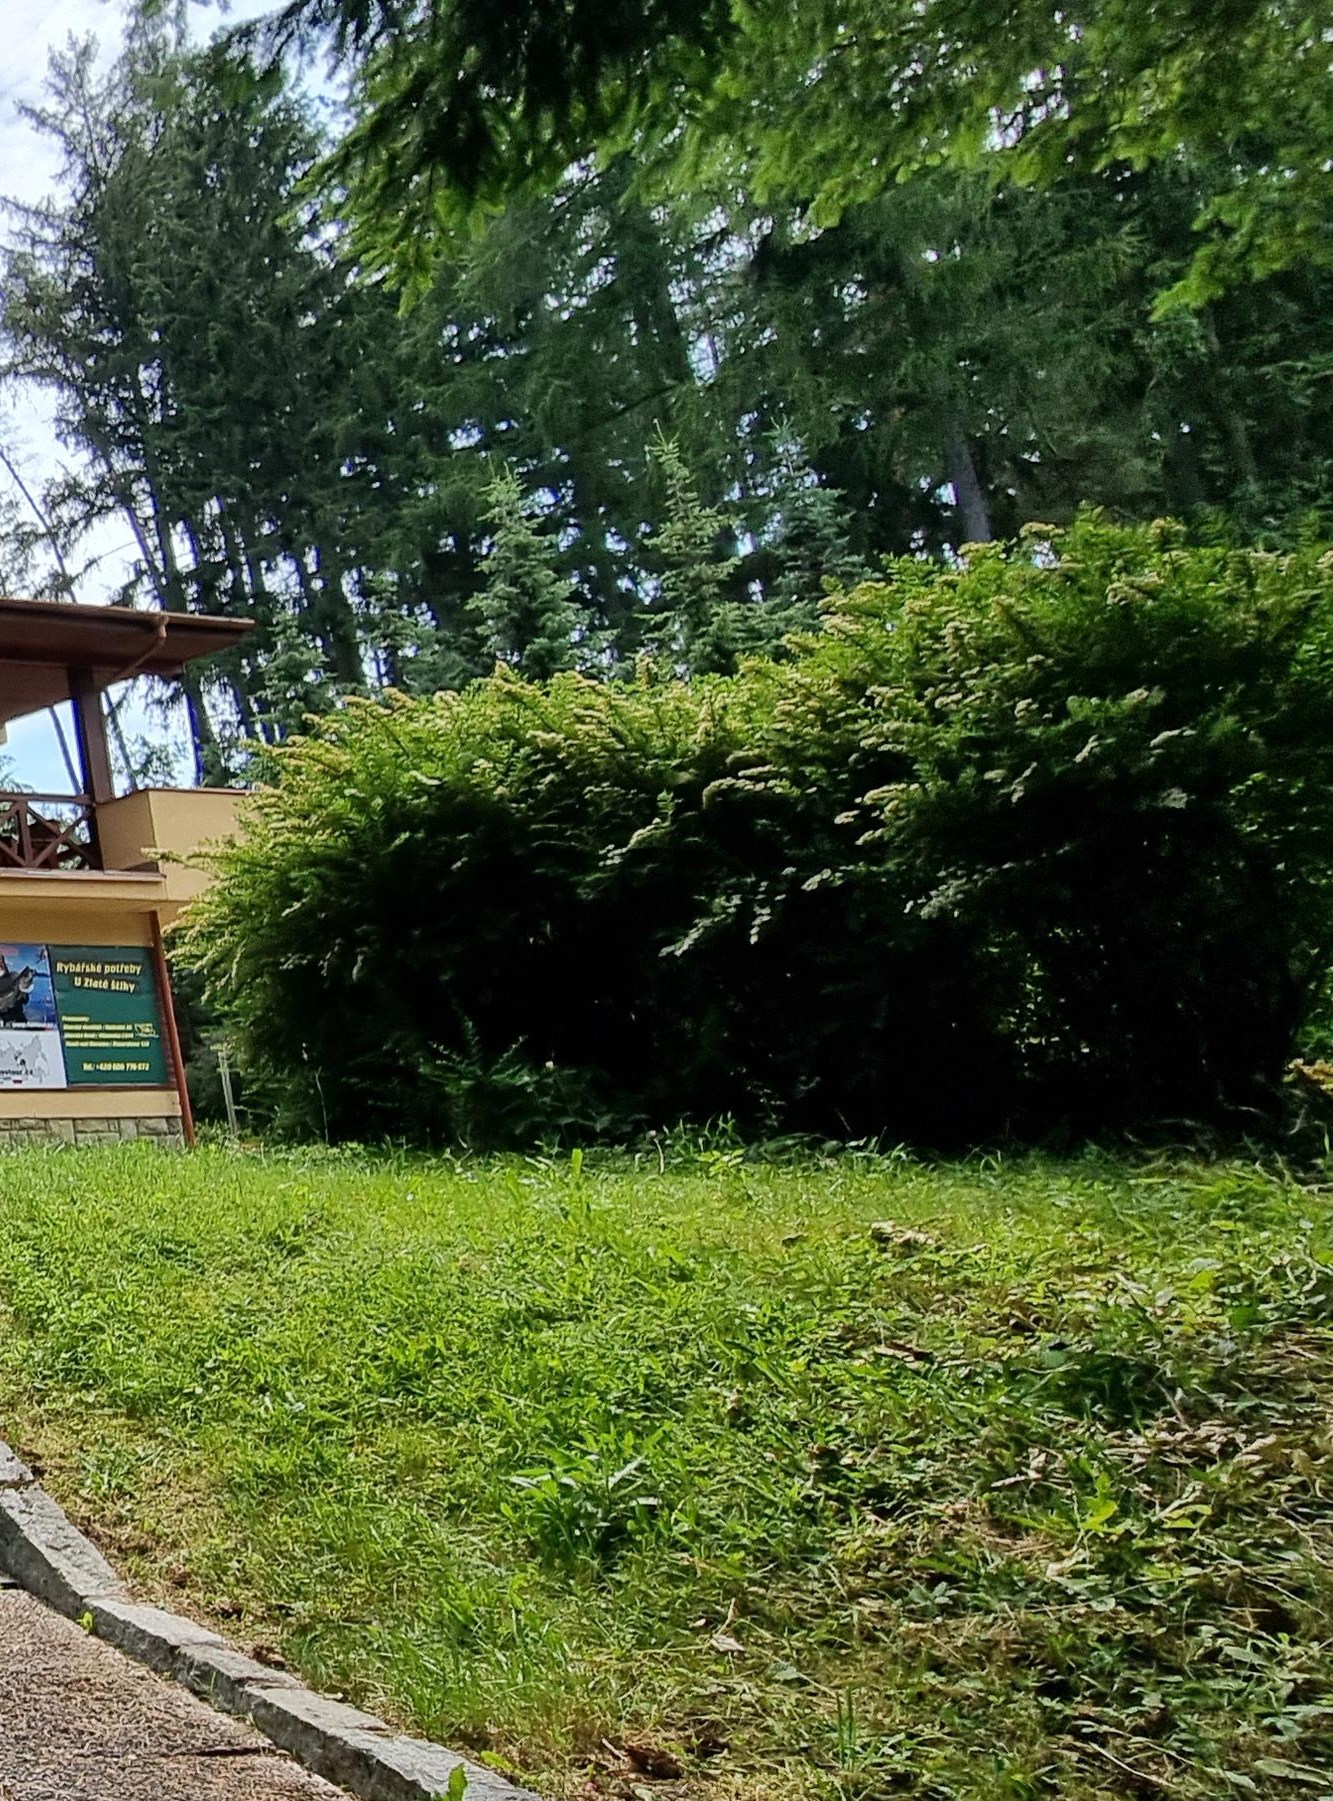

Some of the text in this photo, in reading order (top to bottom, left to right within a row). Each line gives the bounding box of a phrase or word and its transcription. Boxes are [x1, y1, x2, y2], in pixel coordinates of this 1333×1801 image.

[56, 962, 142, 976] Rybářské potřeby
[74, 976, 82, 987] U
